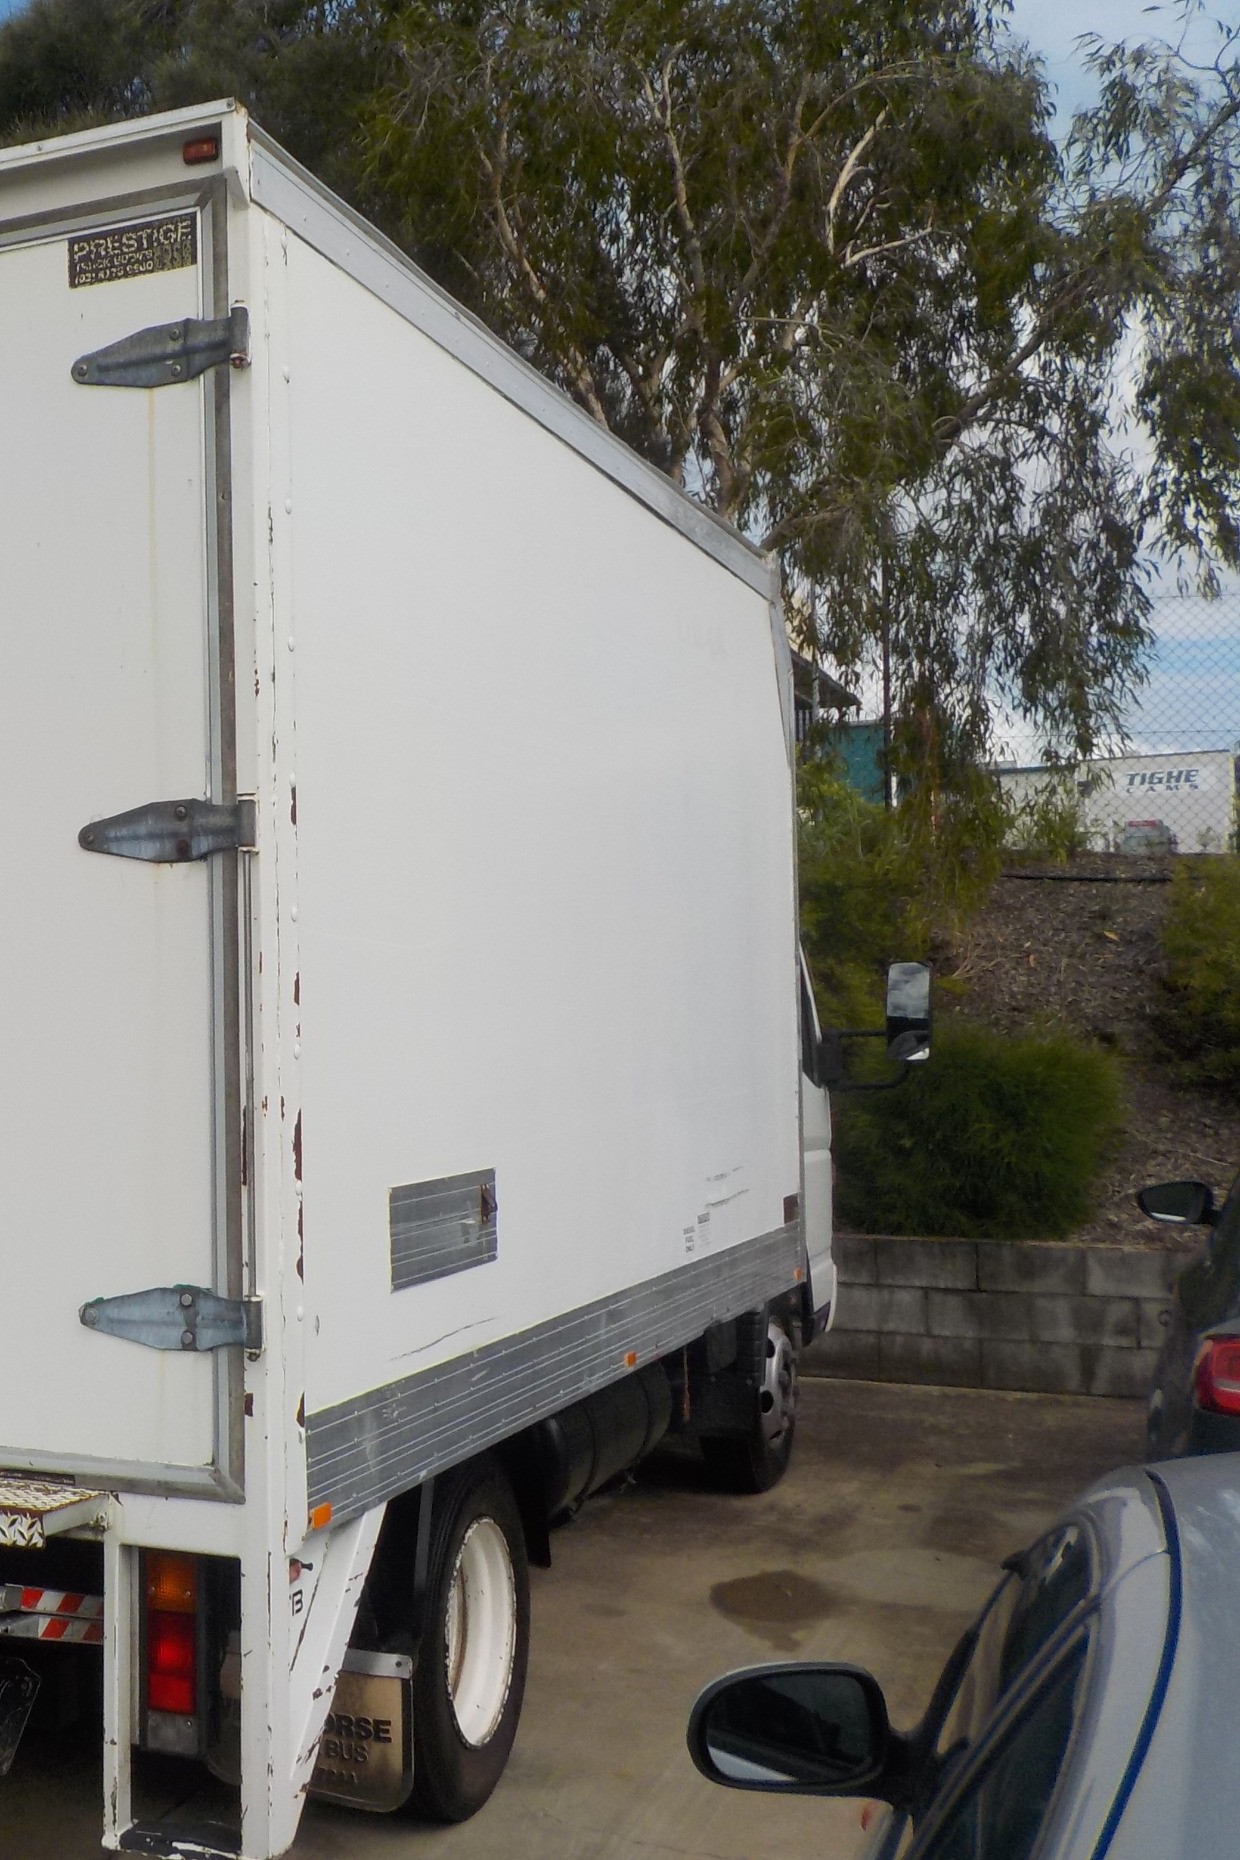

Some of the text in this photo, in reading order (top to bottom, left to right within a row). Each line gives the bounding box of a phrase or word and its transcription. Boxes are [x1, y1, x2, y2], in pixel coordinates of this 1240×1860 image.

[73, 220, 192, 263] PRESTIGE
[1126, 769, 1200, 786] TIGHE
[1126, 783, 1199, 794] CAMS
[323, 1712, 392, 1744] ORSE
[324, 1739, 368, 1762] BUS
